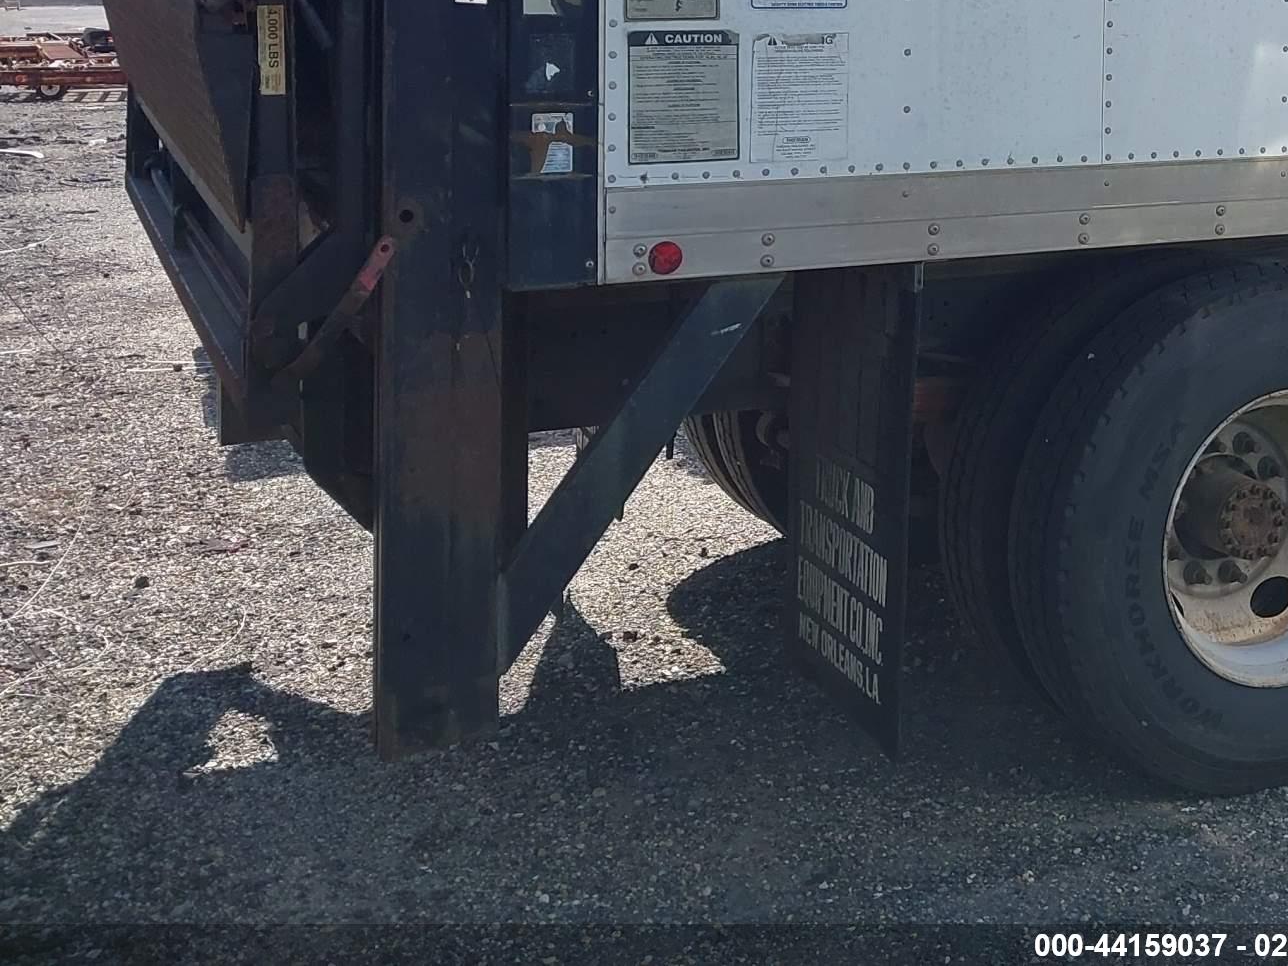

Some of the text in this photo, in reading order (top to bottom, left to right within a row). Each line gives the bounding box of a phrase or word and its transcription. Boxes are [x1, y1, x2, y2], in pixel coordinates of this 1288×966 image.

[268, 43, 280, 69] LBS
[664, 33, 723, 44] CAUTION
[816, 455, 875, 534] TRUCK AND
[799, 499, 888, 608] TRANSPORTATION
[797, 554, 849, 636] EQUIPMENT
[798, 610, 820, 651] NEW
[1124, 515, 1224, 731] WORKHORSE
